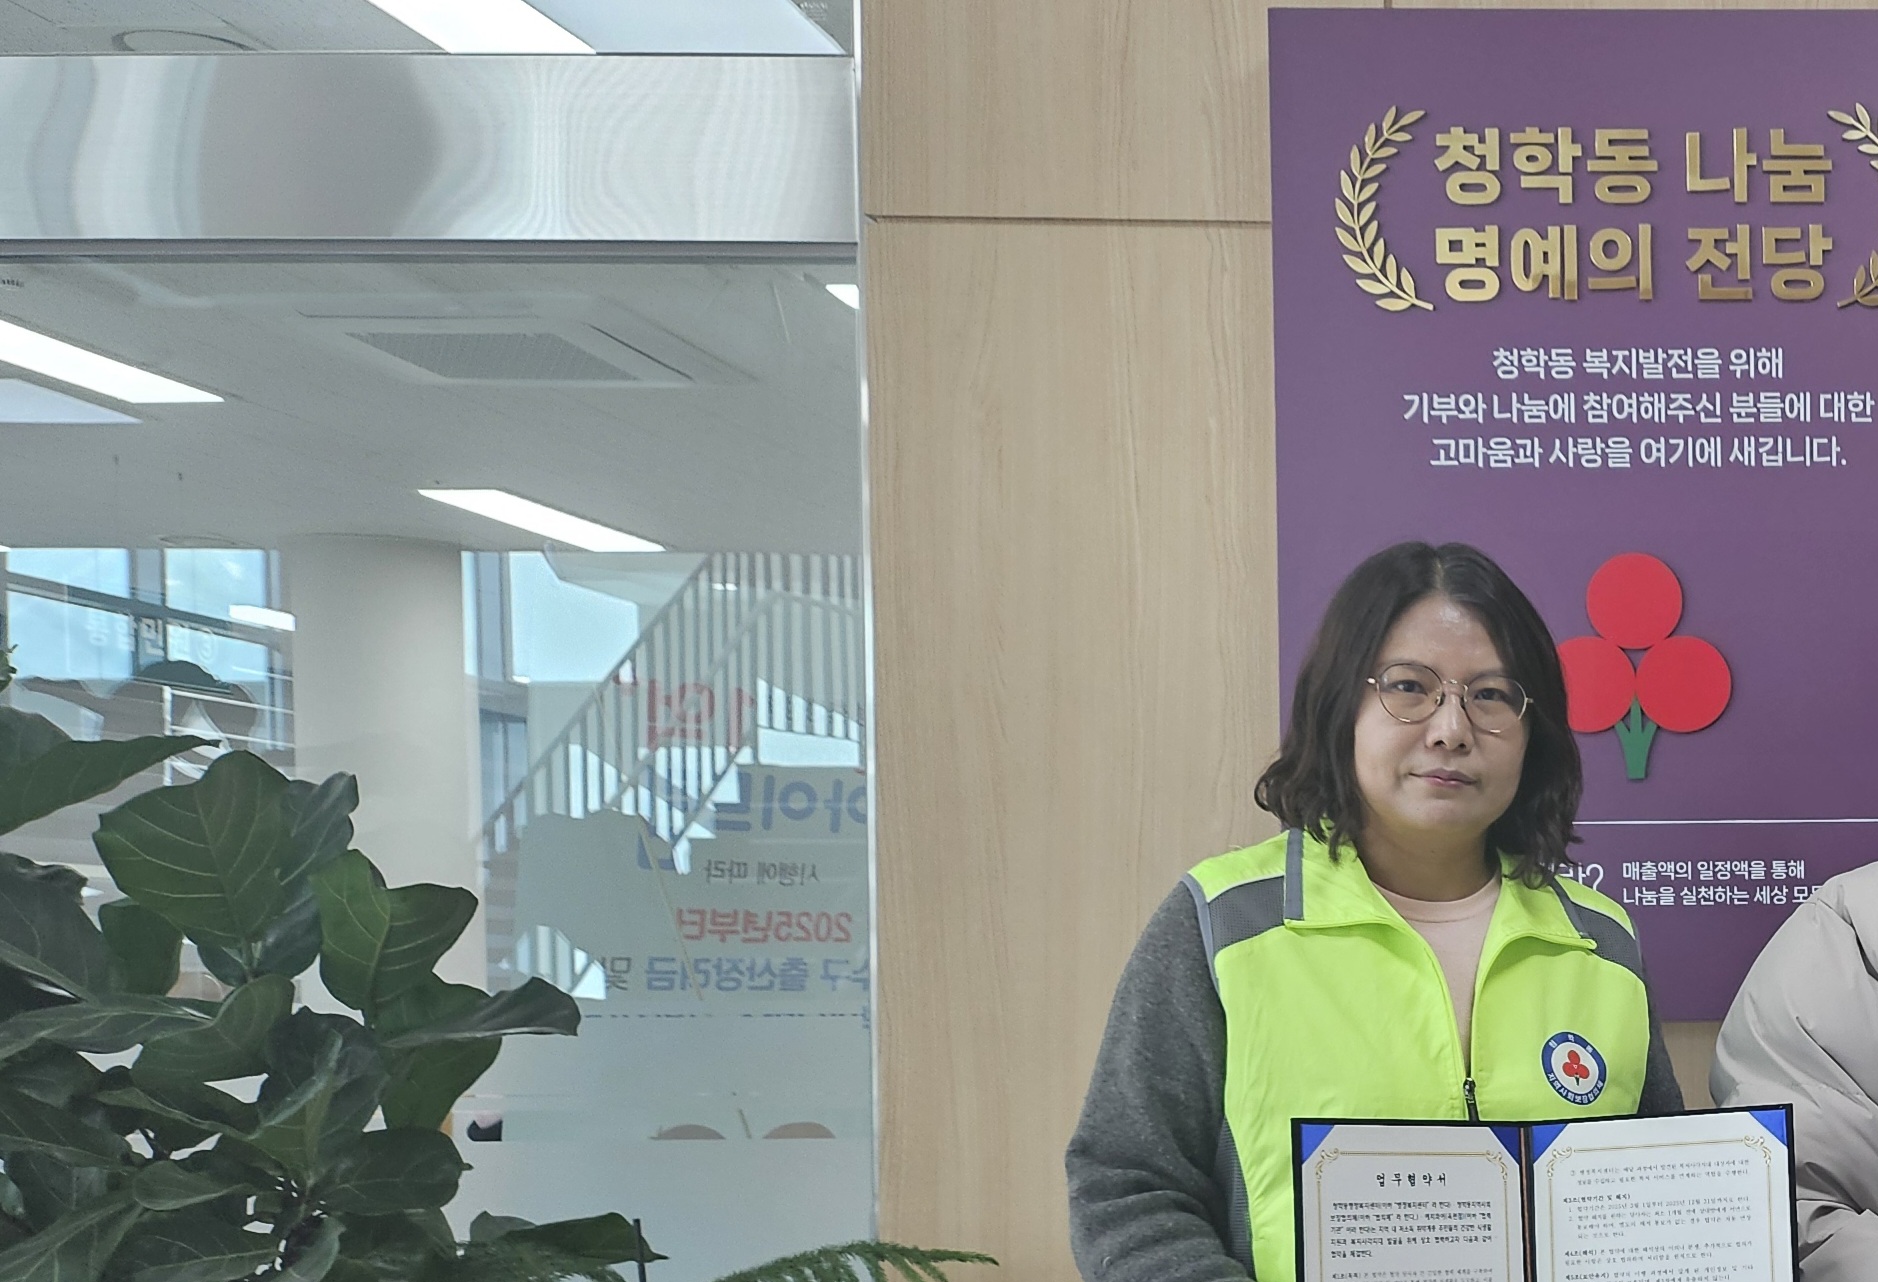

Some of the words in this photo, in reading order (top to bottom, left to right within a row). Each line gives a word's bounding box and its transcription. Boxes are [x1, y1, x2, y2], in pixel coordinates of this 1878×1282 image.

[1434, 127, 1659, 205] 청학동
[1685, 127, 1834, 204] 나눔
[1434, 224, 1652, 301] 명예의
[1686, 224, 1834, 301] 전당
[1492, 348, 1577, 380] 청학동
[1582, 348, 1722, 380] 복지발전을
[1729, 348, 1783, 380] 위해
[1403, 392, 1488, 424] 기부와
[1492, 392, 1576, 424] 나눔에
[1582, 392, 1722, 424] 참여해주신
[1728, 392, 1811, 424] 분들에
[1819, 392, 1876, 424] 대한
[1429, 437, 1544, 468] 고마움과
[1548, 436, 1633, 468] 사랑을
[1640, 436, 1722, 468] 여기에
[1728, 436, 1847, 468] 새깁니다.
[1622, 861, 1692, 881] 매출액의
[1697, 861, 1767, 880] 일정액을
[1770, 860, 1805, 880] 통해
[1622, 886, 1676, 906] 나눔을
[1680, 886, 1750, 906] 실천하는
[1753, 885, 1789, 905] 세상
